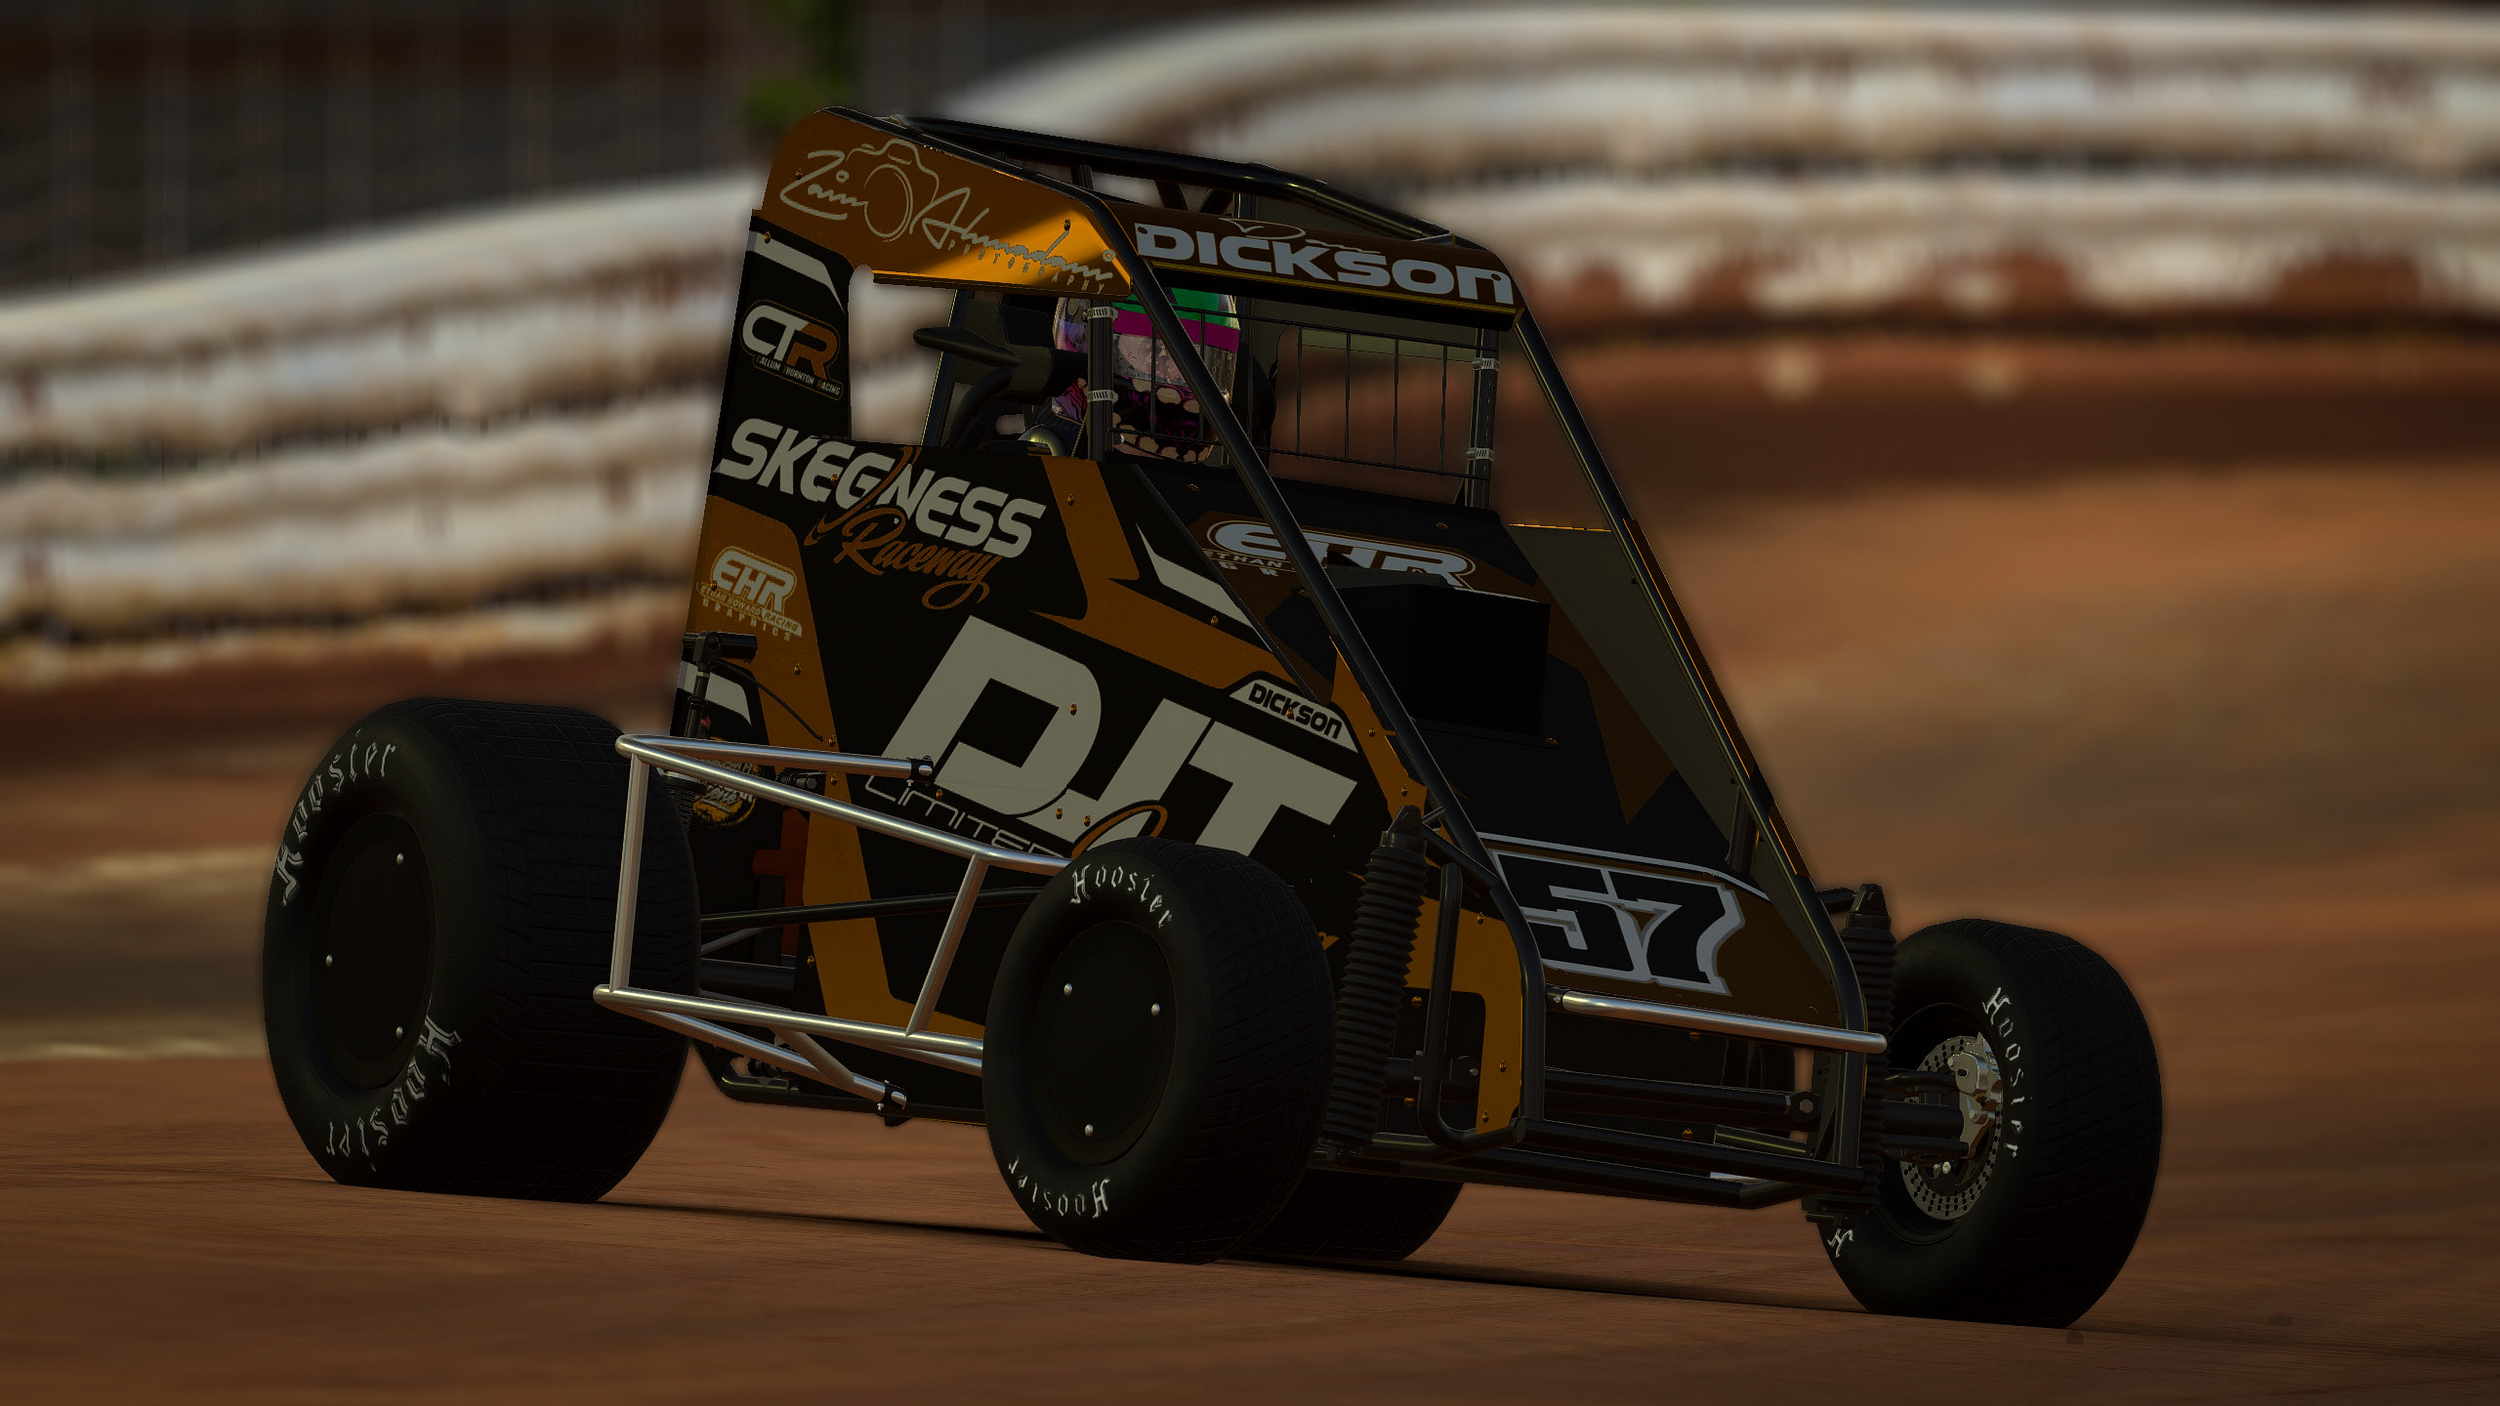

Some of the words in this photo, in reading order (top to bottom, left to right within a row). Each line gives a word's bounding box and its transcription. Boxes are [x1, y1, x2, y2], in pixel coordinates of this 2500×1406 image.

[756, 354, 781, 372] CALLUM
[783, 363, 816, 386] THORNTON
[816, 380, 841, 396] RACING
[713, 417, 1047, 559] SKEGNESS
[712, 549, 795, 614] EHR
[834, 507, 1003, 611] Raceway
[702, 597, 791, 642] GRAPHICS
[727, 596, 760, 616] HOWARD
[764, 612, 799, 632] RACING
[878, 614, 1358, 857] DJT
[1249, 683, 1343, 739] DICKSON
[275, 728, 397, 906] Hoosier
[1069, 862, 1173, 929] Hoosier
[1494, 851, 1735, 990] 57
[325, 1002, 462, 1172] Hoosier
[1982, 986, 2034, 1158] Hoosier
[1008, 1156, 1111, 1220] Hoosier
